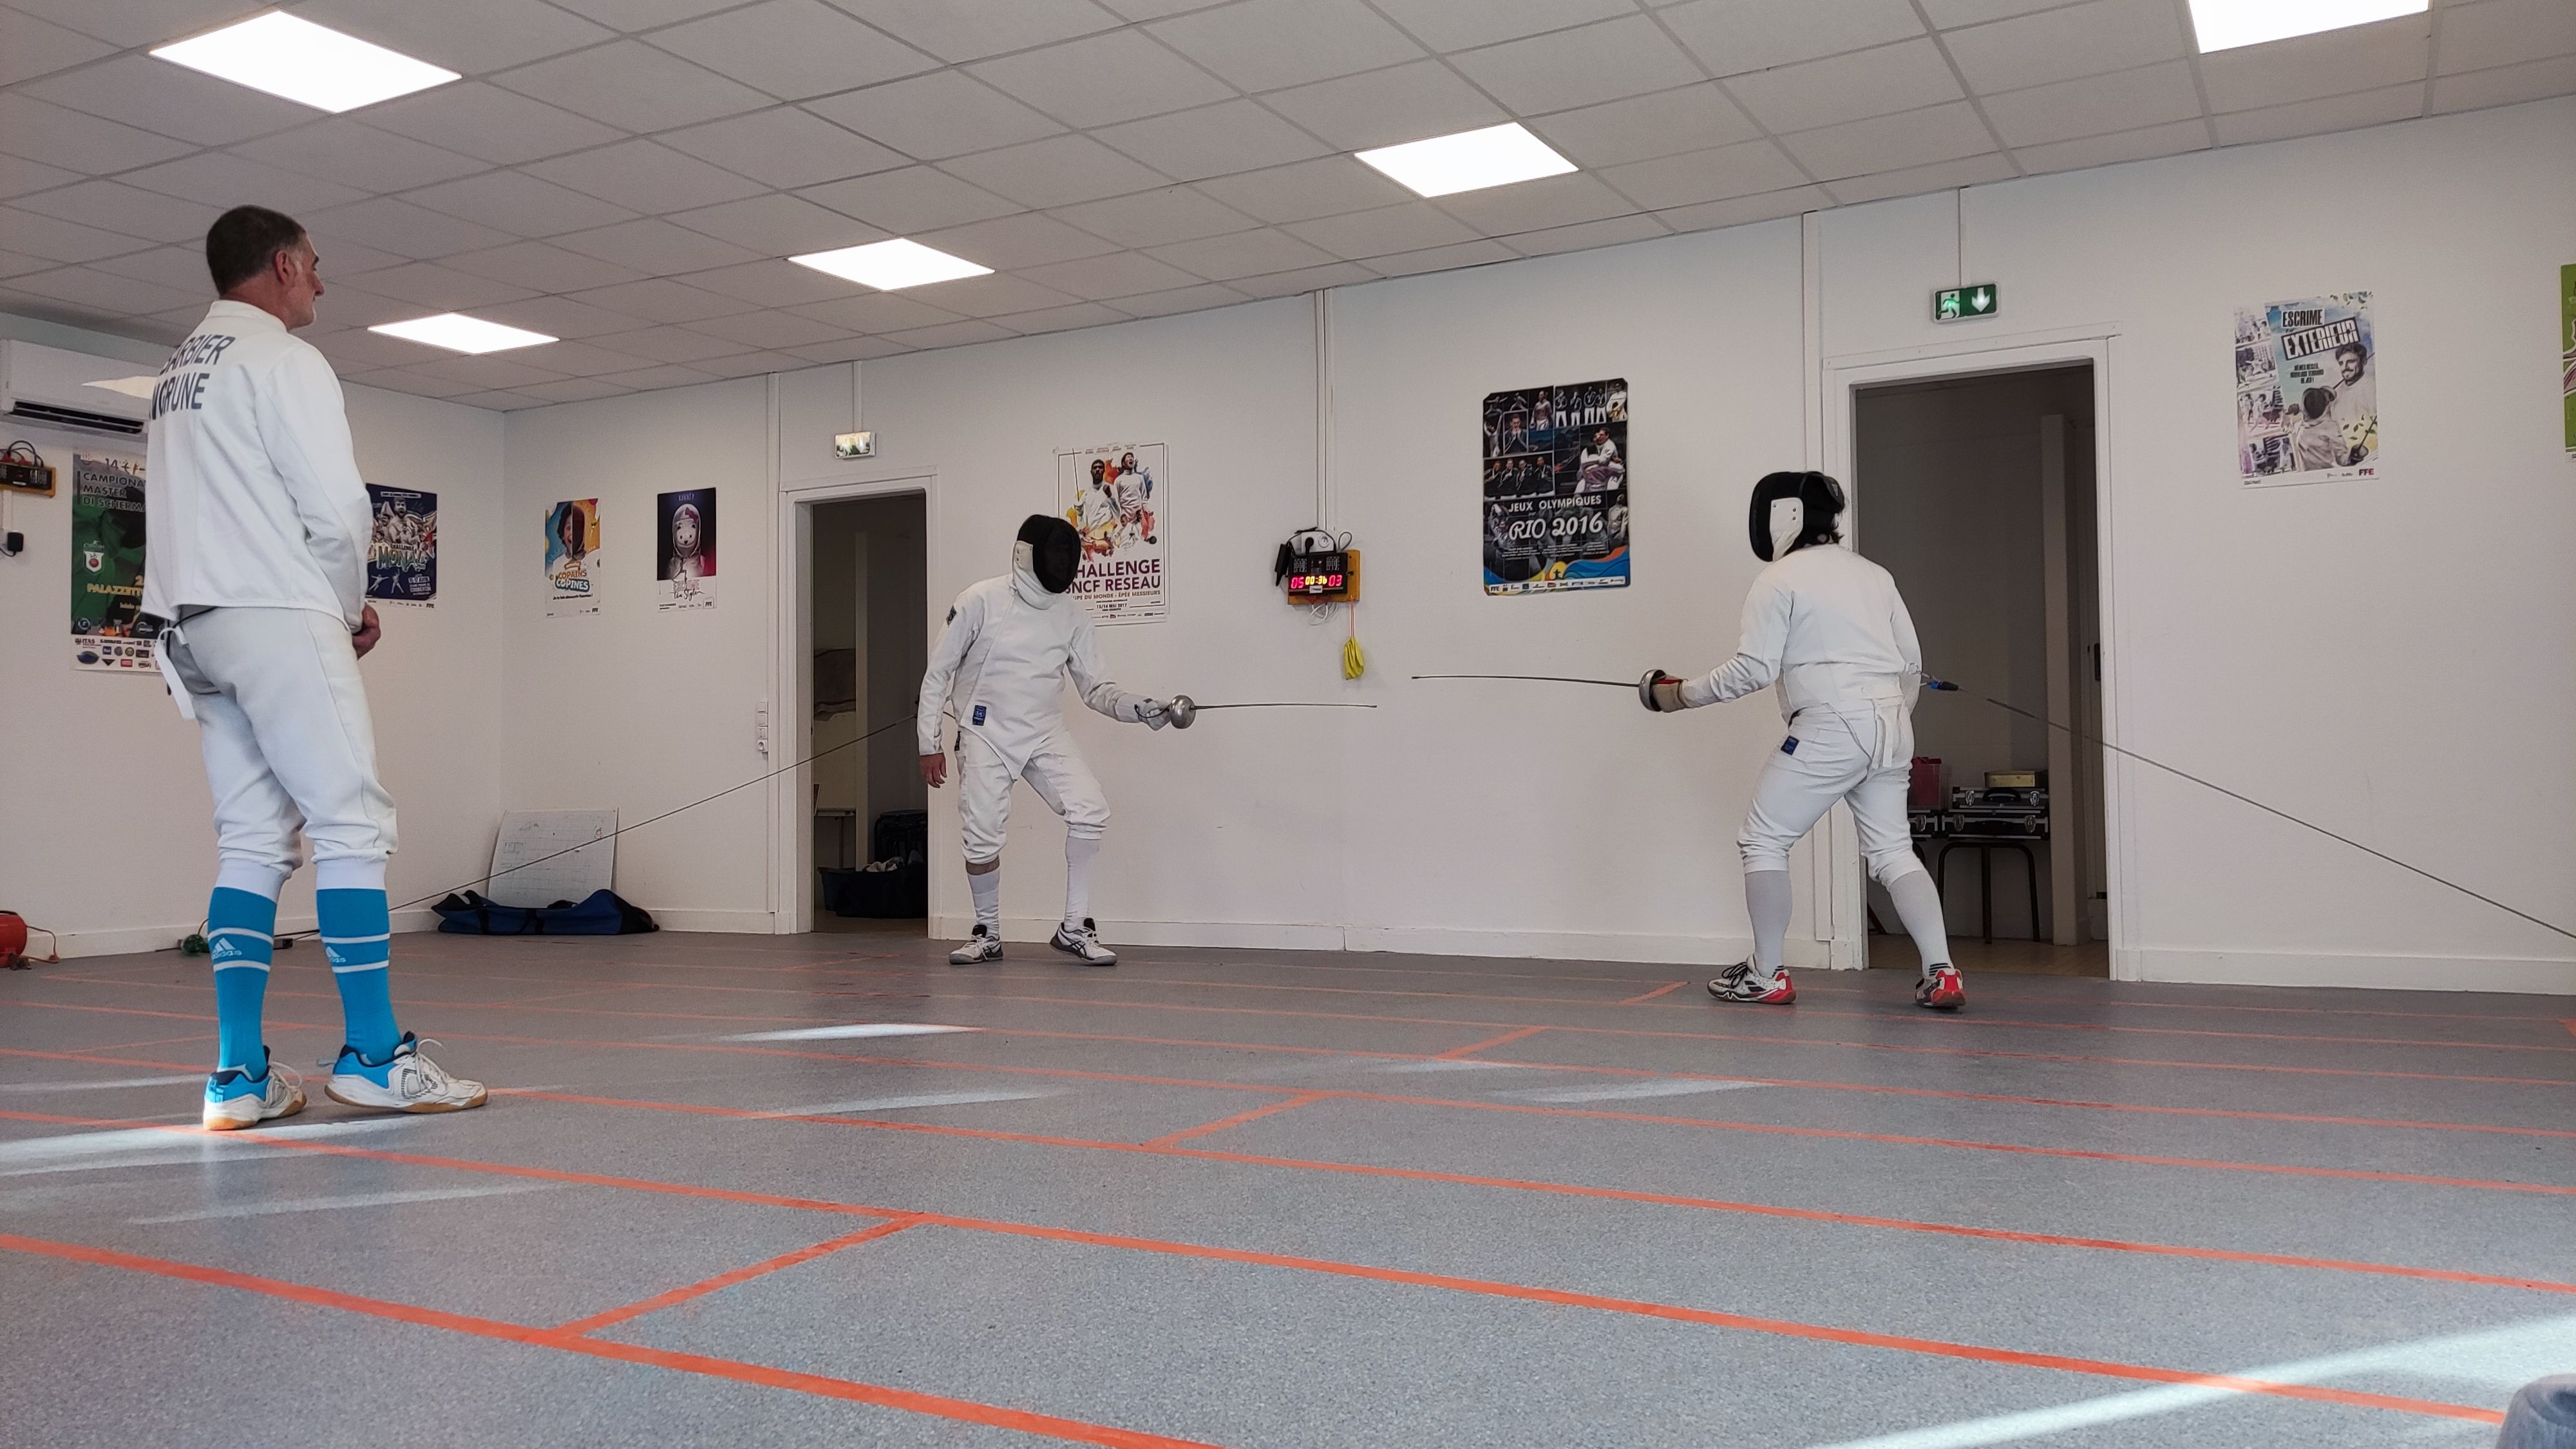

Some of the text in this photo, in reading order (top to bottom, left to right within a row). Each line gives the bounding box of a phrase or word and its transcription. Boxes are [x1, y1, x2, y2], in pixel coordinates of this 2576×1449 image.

[2282, 309, 2323, 327] ESCRIME
[2283, 319, 2359, 359] EXTERIEUR
[149, 372, 210, 421] NGRUNE
[83, 473, 146, 488] CAMPIONA
[83, 484, 127, 498] MASTER
[83, 497, 94, 506] DI
[1508, 495, 1602, 513] JEUX OLYMPIQUES
[1509, 511, 1604, 540] RIO 2016
[1075, 558, 1160, 578] HALLENGE
[87, 583, 143, 596] PALAZZETT
[556, 580, 589, 591] COPINES
[1105, 575, 1160, 591] RESEAU
[1291, 576, 1304, 589] 05
[1329, 574, 1343, 587] 03
